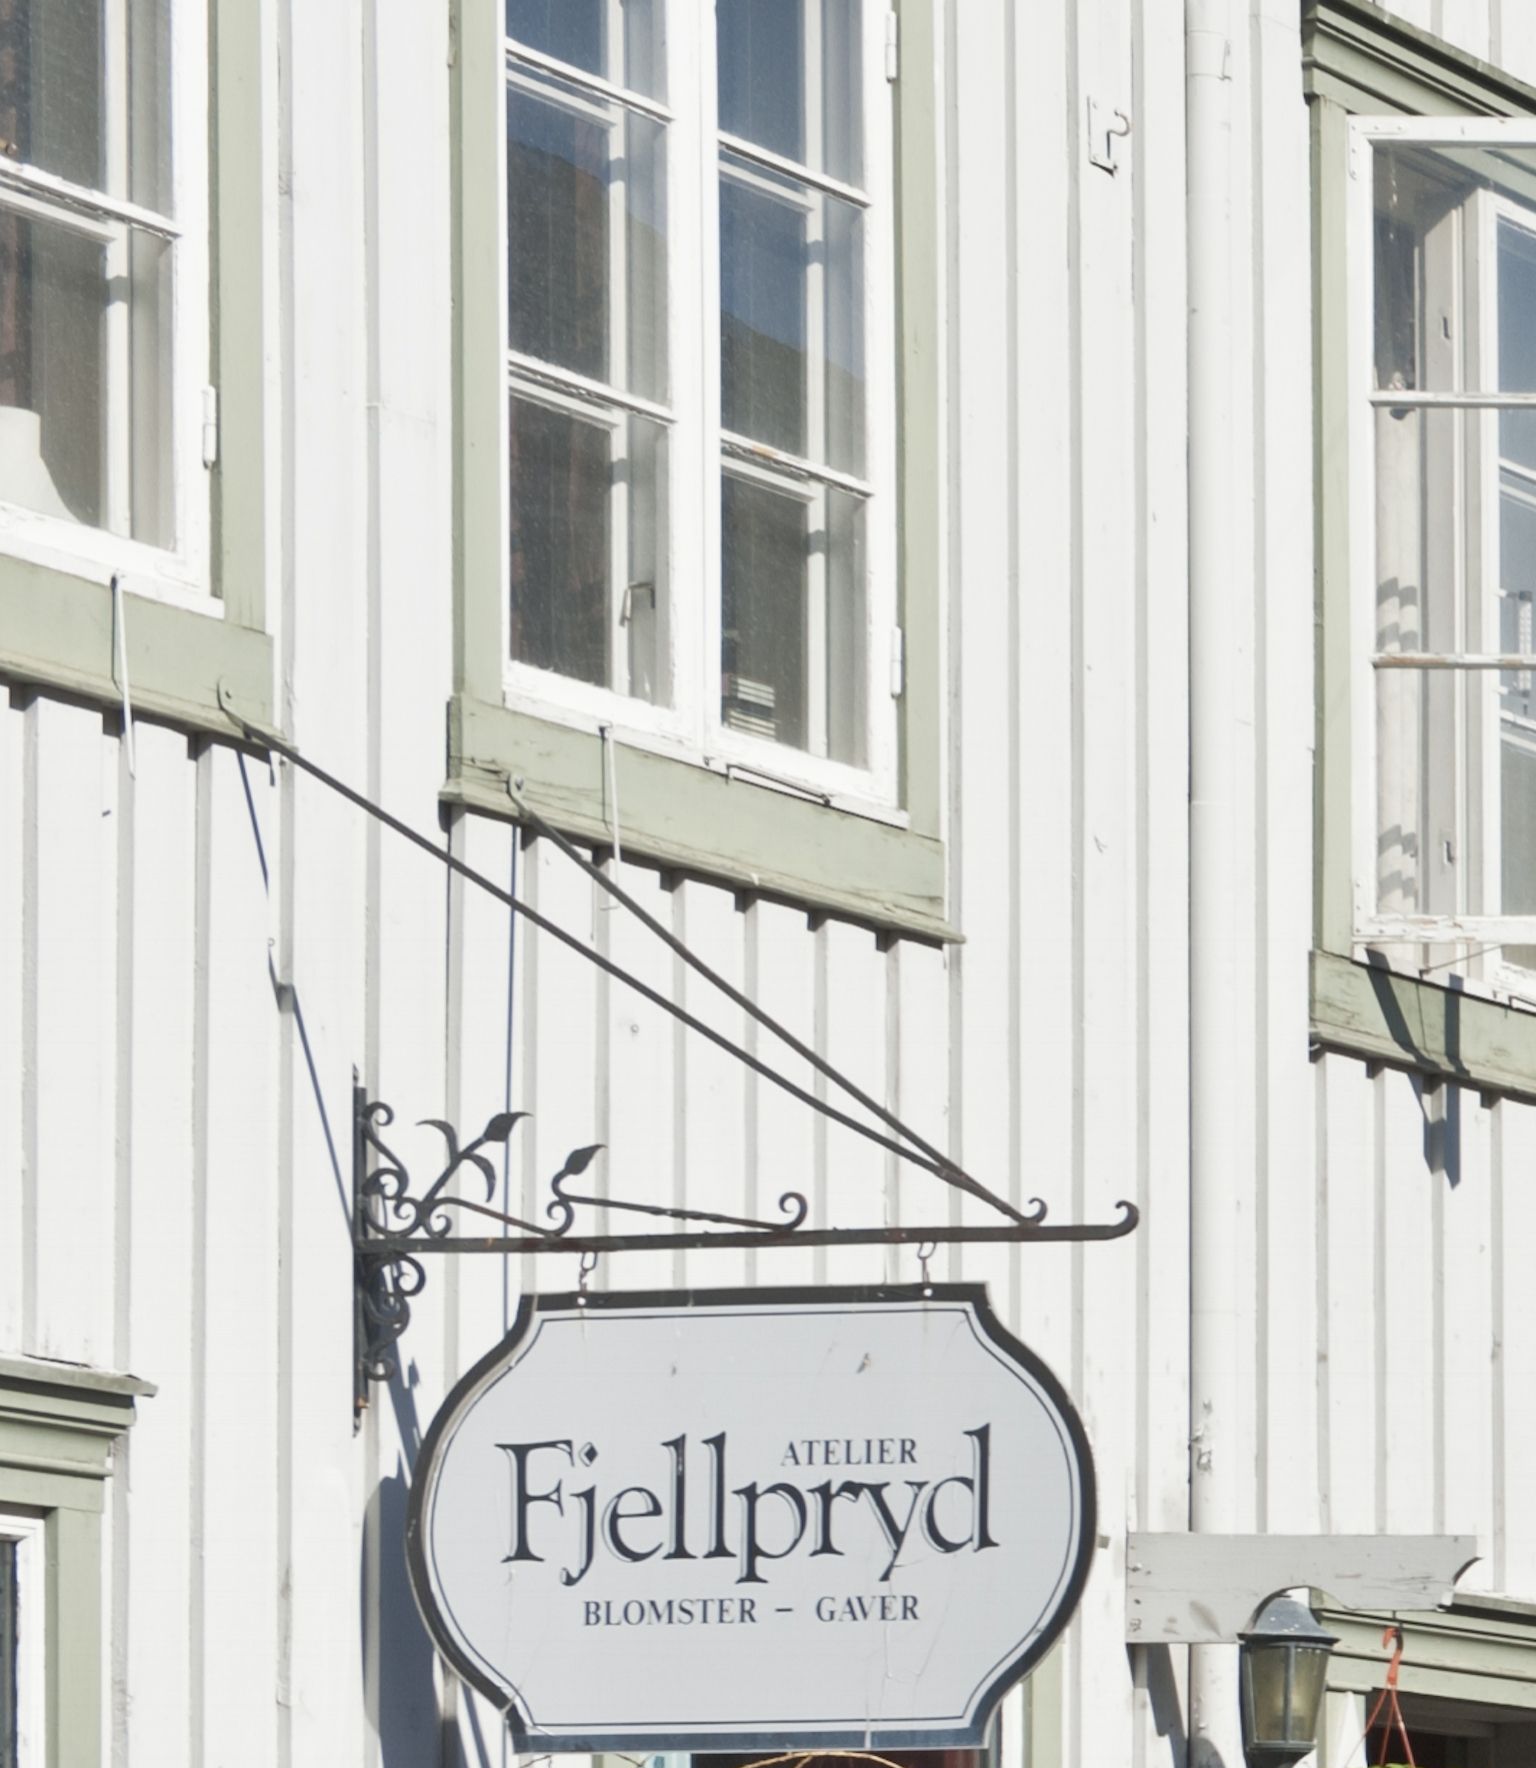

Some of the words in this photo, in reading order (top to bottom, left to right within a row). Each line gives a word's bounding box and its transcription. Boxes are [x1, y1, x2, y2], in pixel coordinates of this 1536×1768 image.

[781, 1437, 918, 1467] ATELIER
[495, 1423, 1000, 1586] Fjellpryd
[583, 1598, 758, 1628] BLOMSTER
[816, 1594, 921, 1624] GAVER
